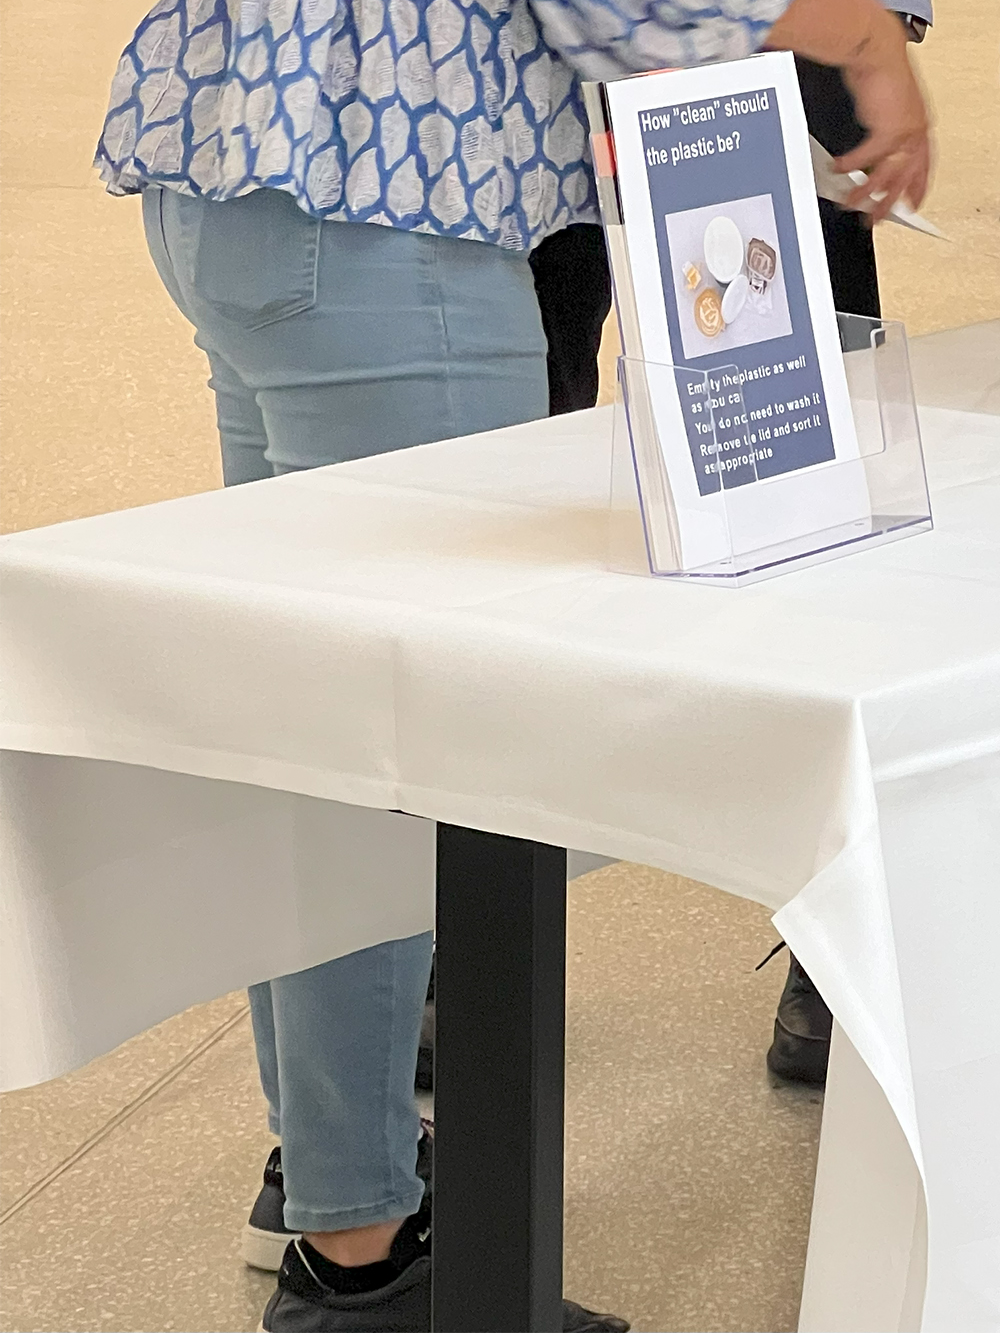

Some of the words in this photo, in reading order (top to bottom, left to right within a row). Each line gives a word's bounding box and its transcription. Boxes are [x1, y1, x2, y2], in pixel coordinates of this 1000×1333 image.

[641, 112, 671, 132] How
[724, 92, 770, 117] should
[646, 146, 668, 166] the
[671, 137, 715, 166] plastic
[716, 131, 741, 153] be?
[722, 374, 738, 387] the
[739, 365, 771, 386] plastic
[773, 363, 784, 374] as
[786, 355, 807, 371] well
[691, 402, 703, 414] as
[718, 417, 731, 429] do
[750, 404, 773, 421] need
[774, 403, 785, 415] to
[786, 395, 811, 411] wash
[812, 393, 820, 405] it
[757, 427, 772, 441] lid
[773, 422, 791, 437] and
[792, 417, 812, 432] sort
[813, 414, 821, 427] it
[704, 463, 717, 475] as
